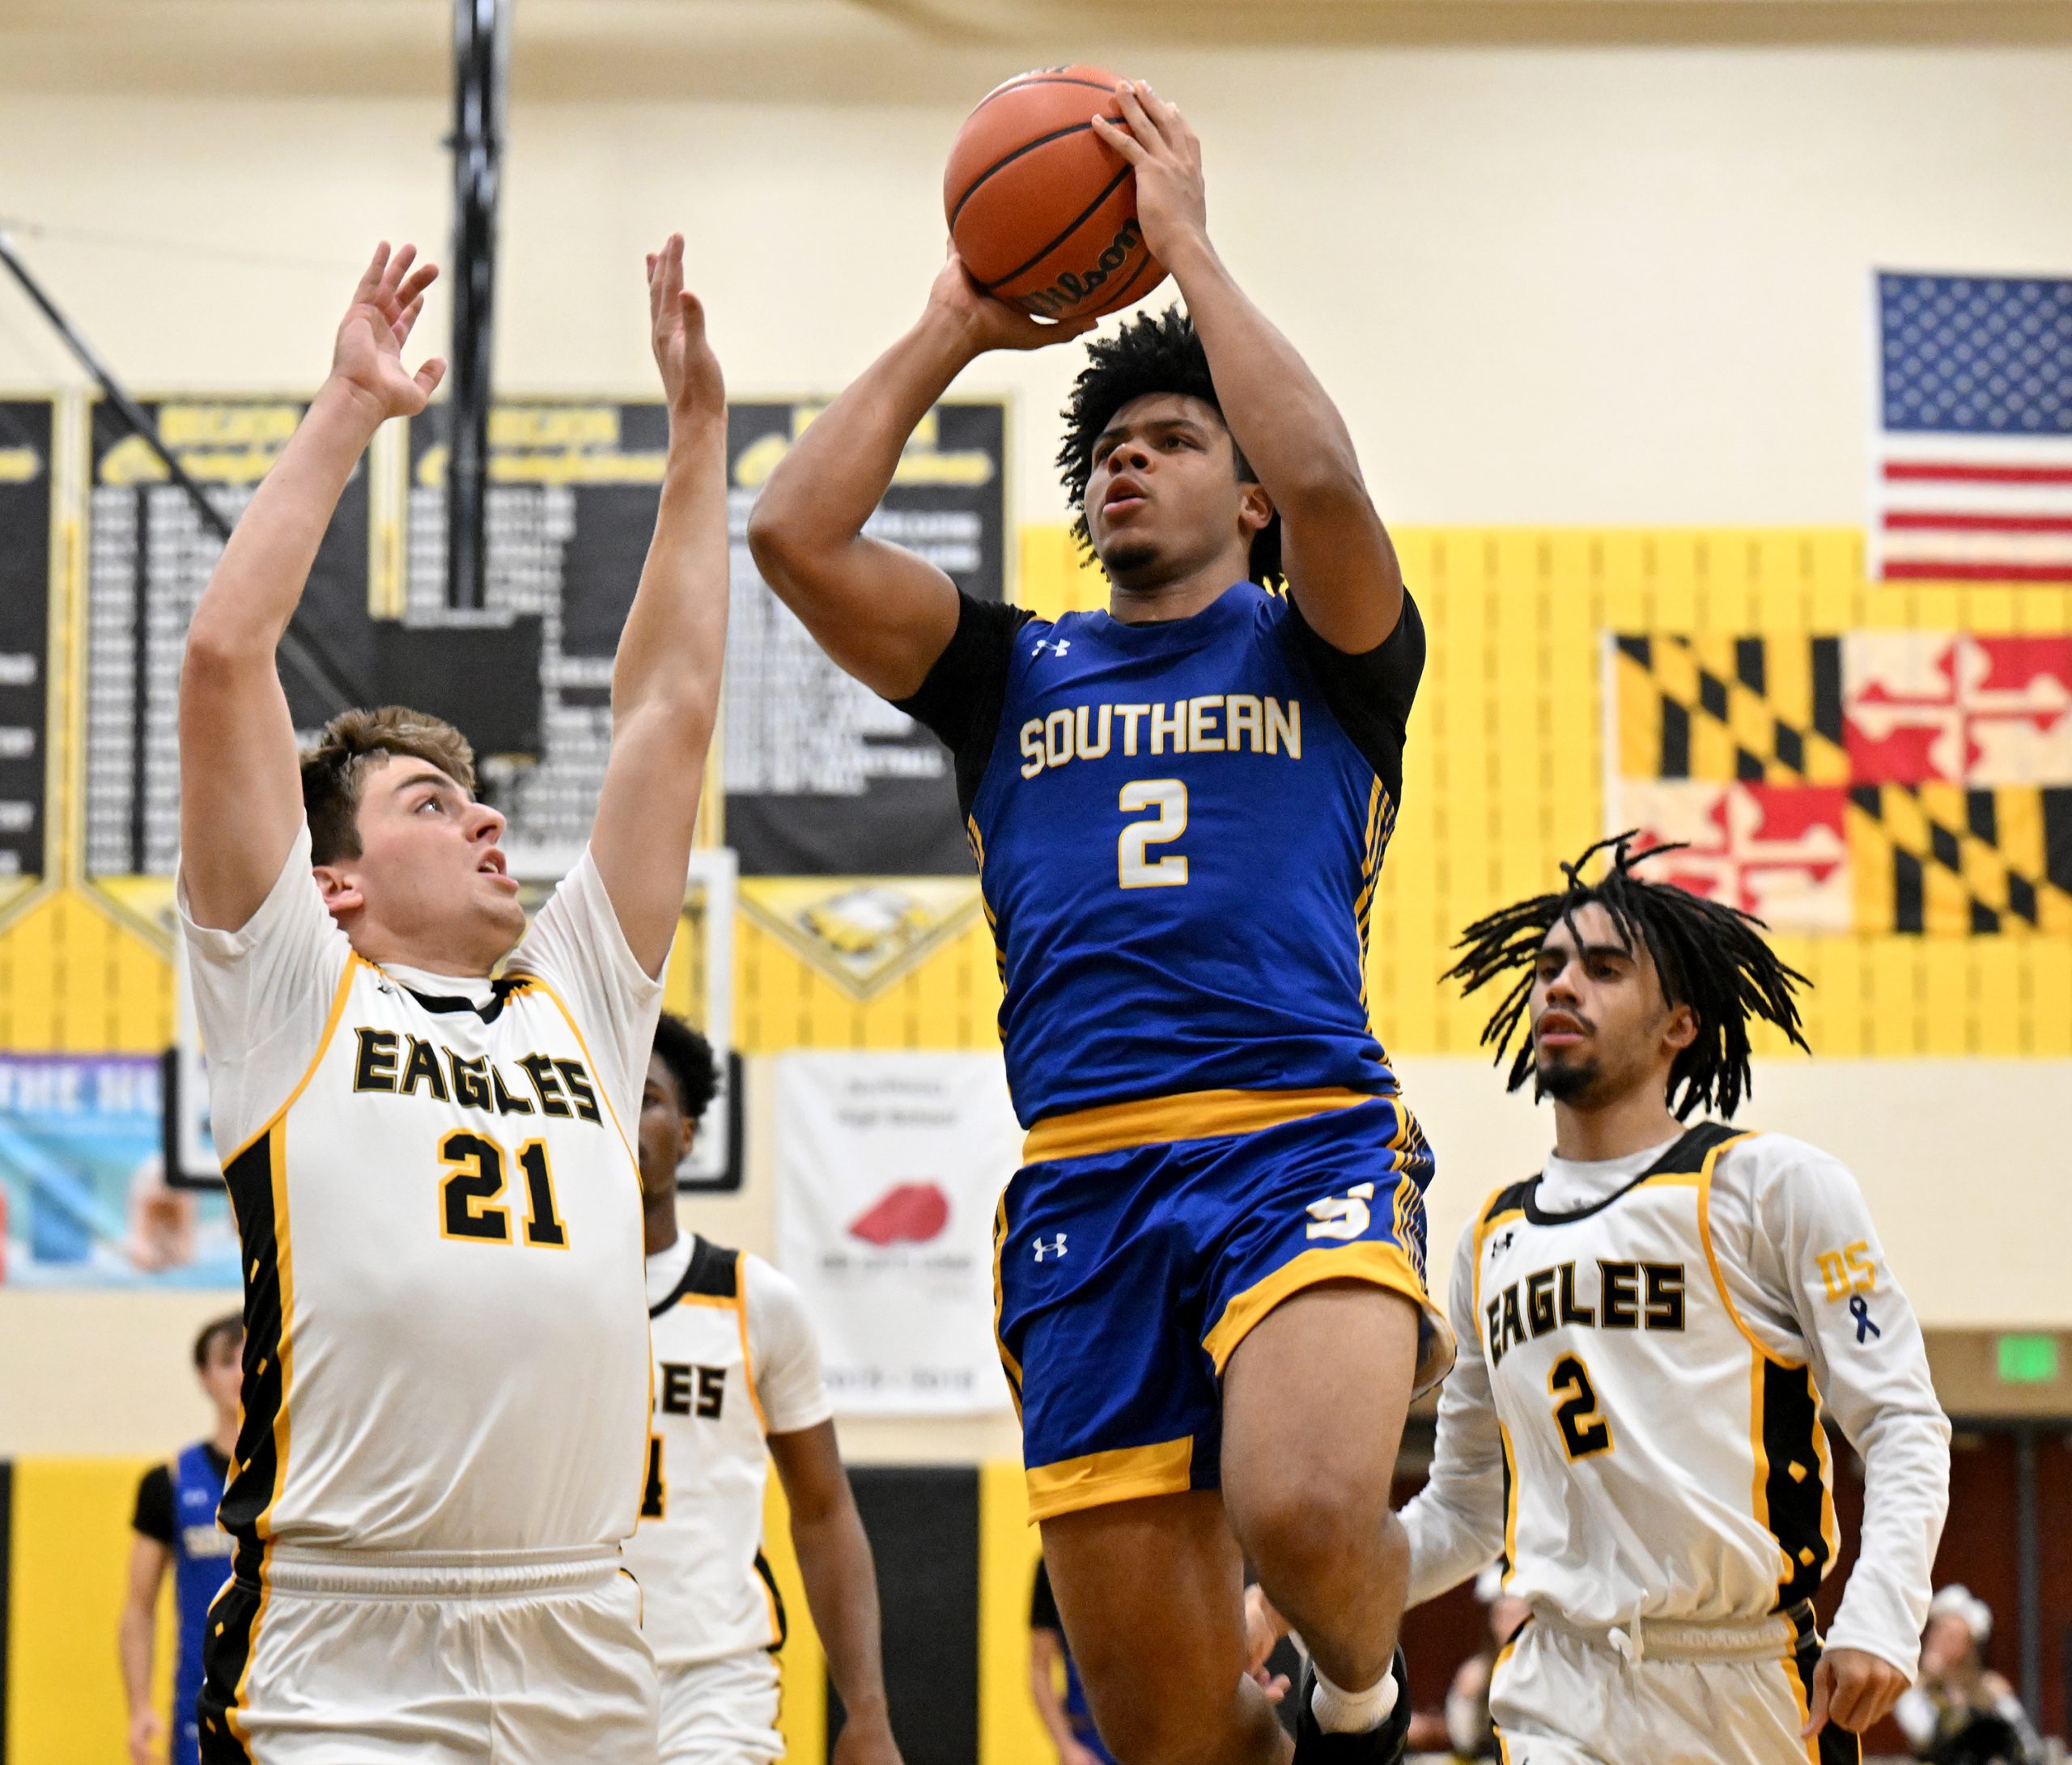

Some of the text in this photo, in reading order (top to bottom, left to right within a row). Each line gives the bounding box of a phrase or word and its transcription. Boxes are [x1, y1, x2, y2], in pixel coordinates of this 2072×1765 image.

[1020, 694, 1301, 779] SOUTHERN
[1118, 778, 1188, 889] 2
[353, 1026, 604, 1128] EAGLES
[437, 1126, 571, 1251] 21
[1485, 1258, 1686, 1369] EAGLES
[1815, 1239, 1876, 1304] DS
[1547, 1350, 1615, 1463] 2
